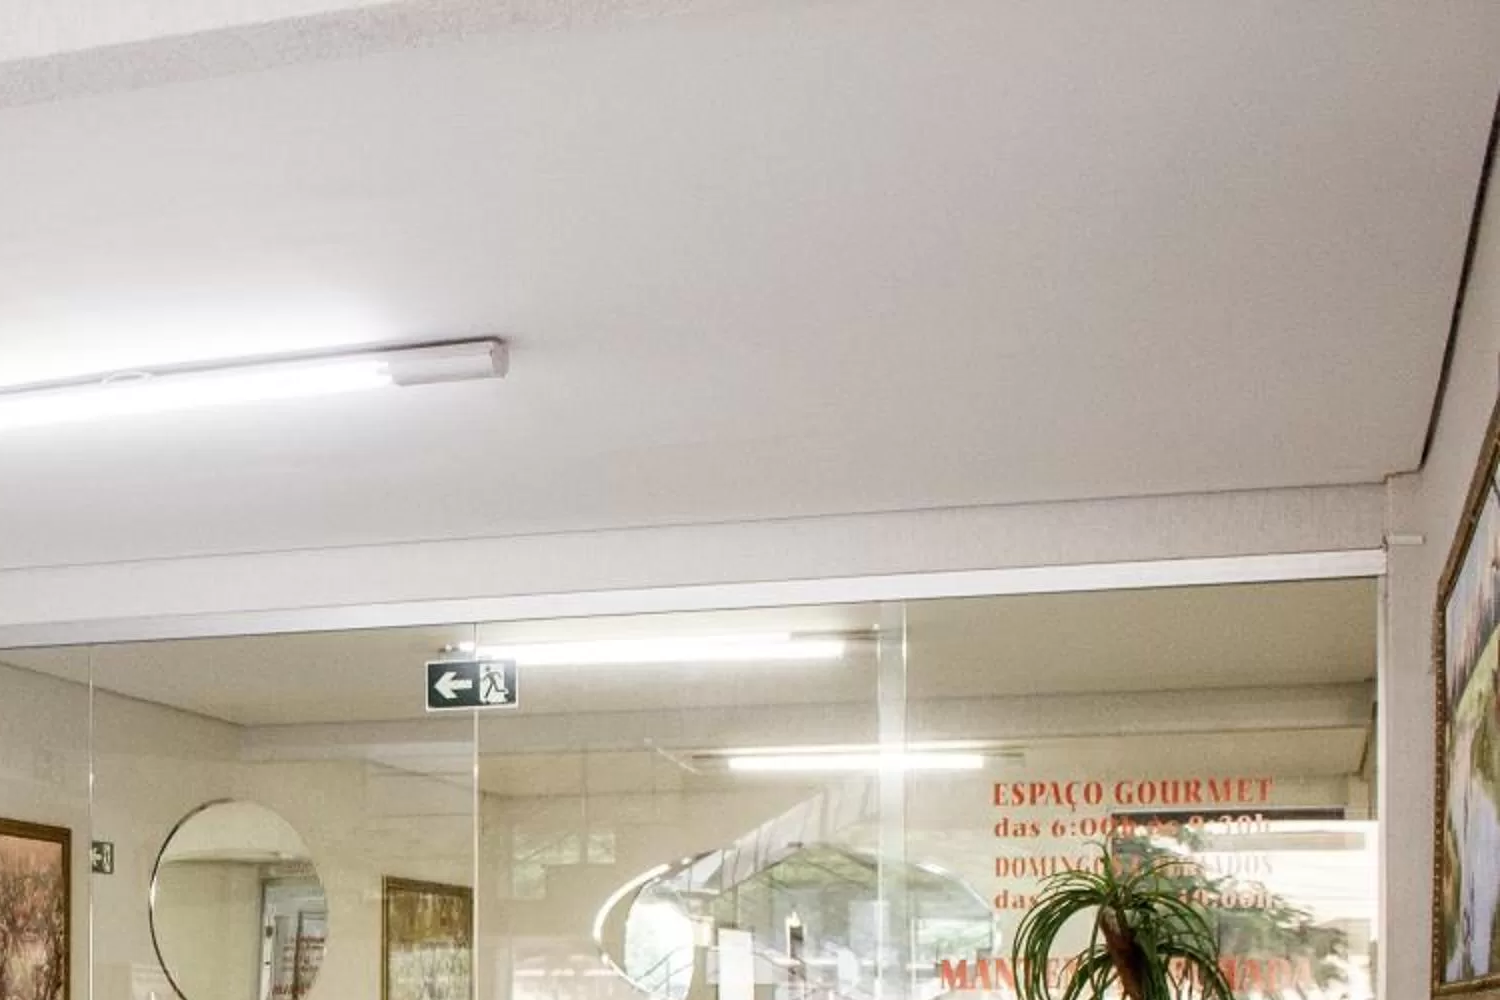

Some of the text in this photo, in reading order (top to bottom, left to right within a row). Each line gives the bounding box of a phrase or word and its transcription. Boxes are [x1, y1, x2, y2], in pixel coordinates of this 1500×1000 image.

[993, 777, 1275, 812] ESPAÇO GOURMET
[994, 816, 1041, 838] das
